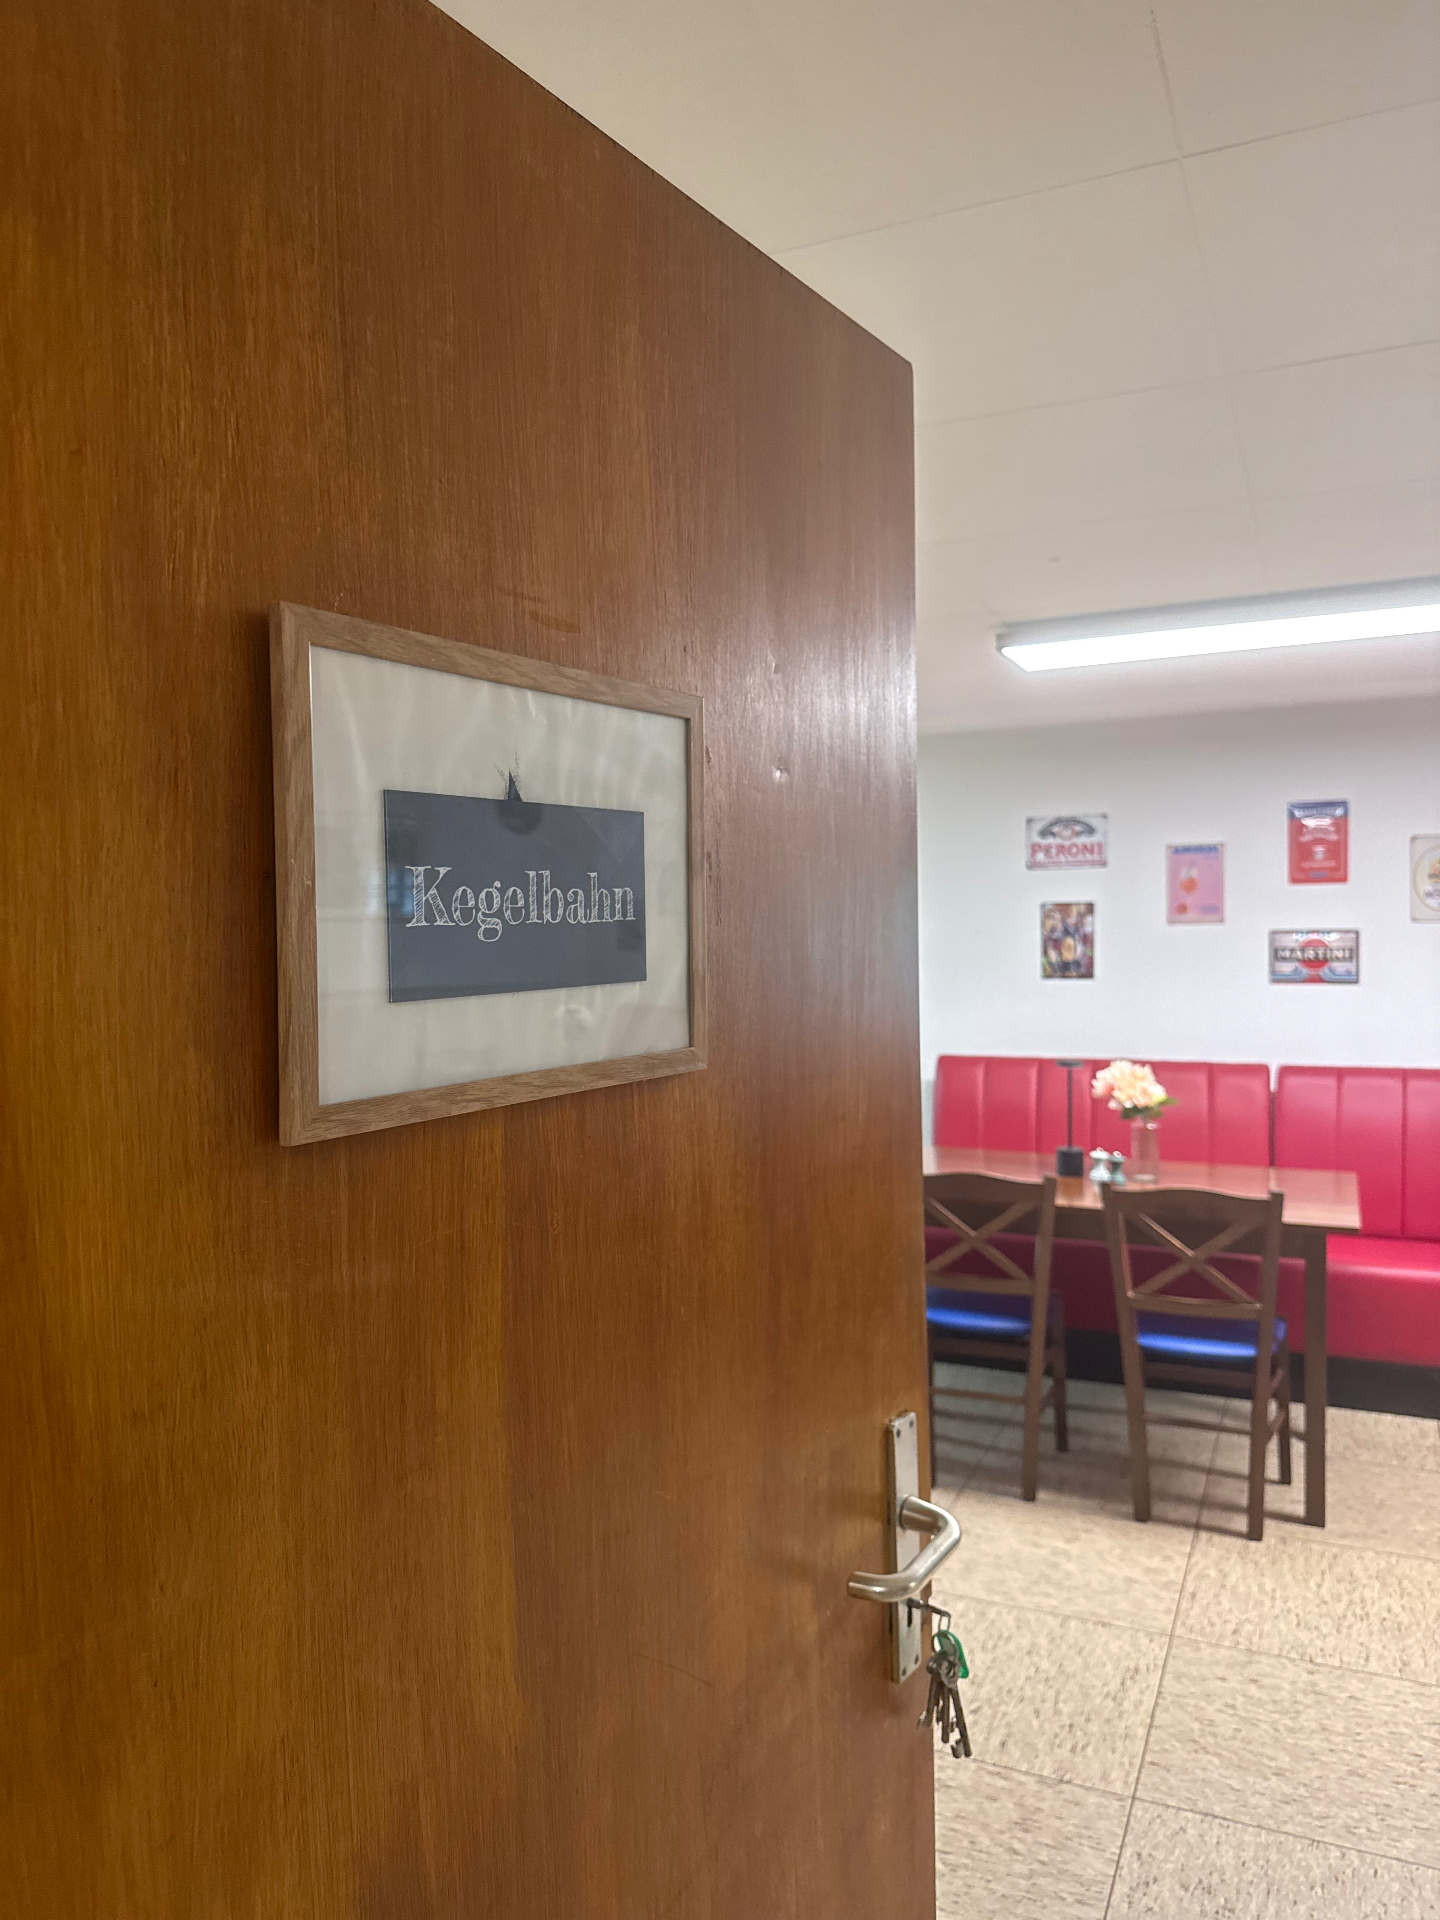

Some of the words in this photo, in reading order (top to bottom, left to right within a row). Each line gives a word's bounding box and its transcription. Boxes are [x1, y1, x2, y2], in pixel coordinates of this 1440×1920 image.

[1031, 842, 1103, 860] PERONI
[405, 866, 636, 942] Kegelbahn
[1276, 948, 1351, 961] MARTINI
